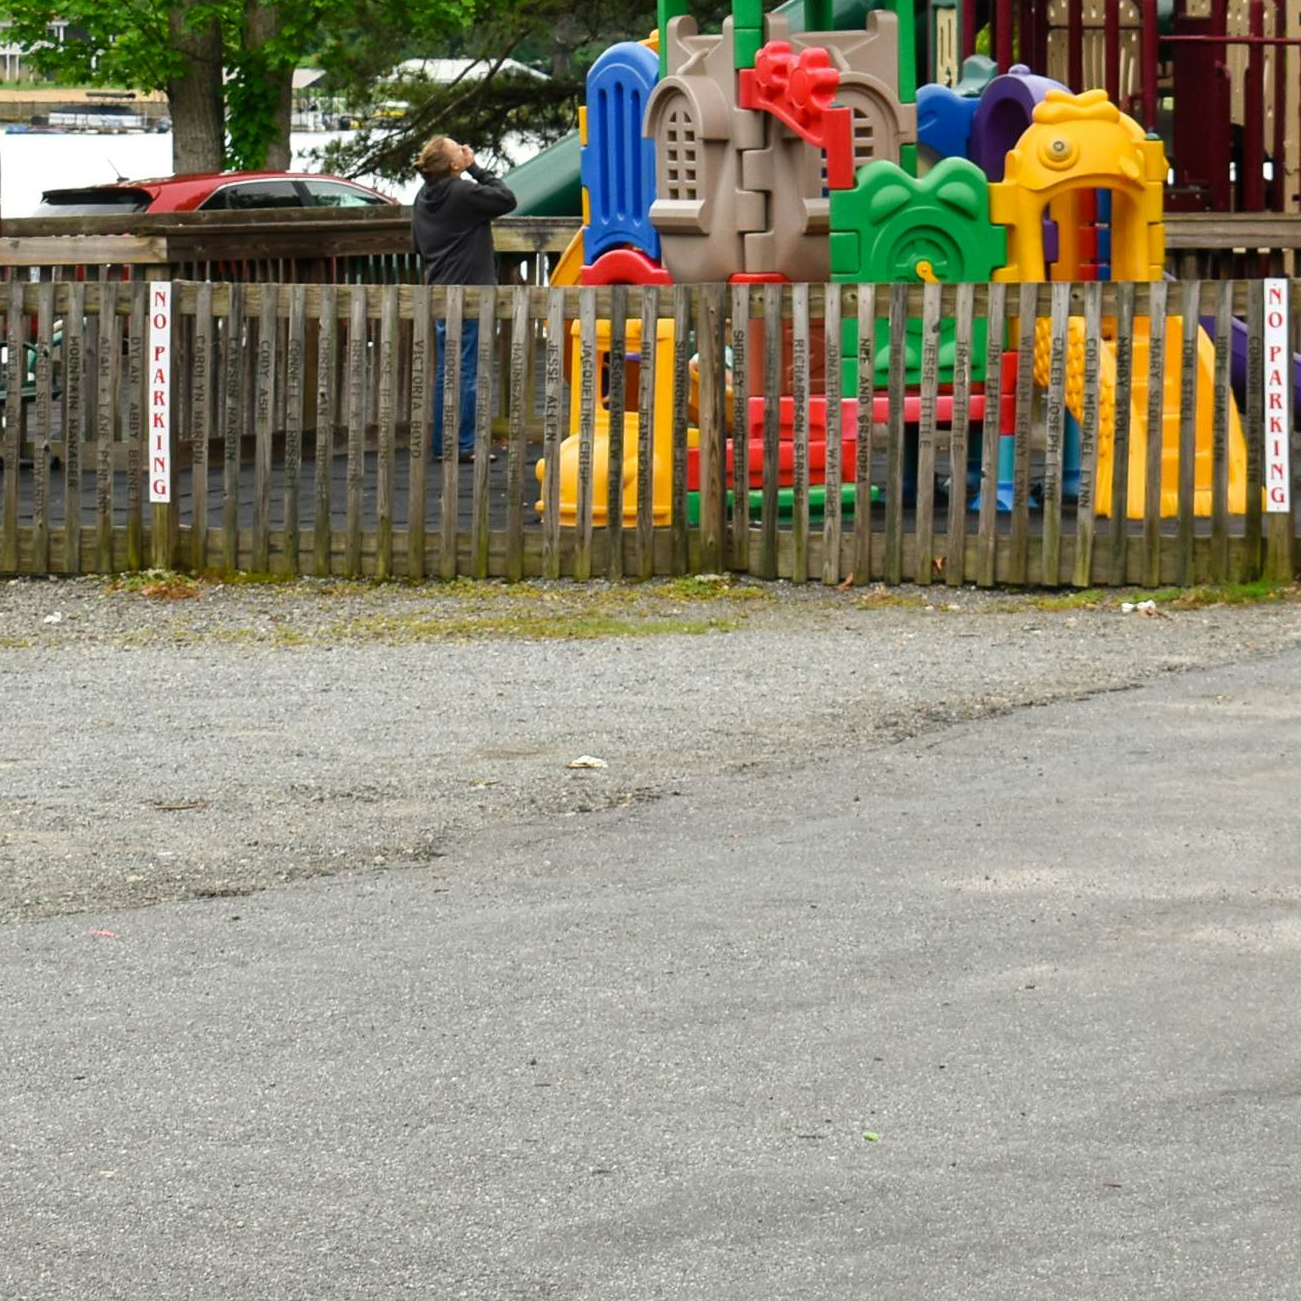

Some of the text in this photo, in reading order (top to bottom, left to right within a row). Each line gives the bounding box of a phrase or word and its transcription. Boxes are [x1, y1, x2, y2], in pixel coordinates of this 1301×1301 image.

[100, 337, 110, 377] ADAM
[130, 336, 141, 384] DYLAN
[153, 291, 167, 496] NO PARKING
[259, 340, 270, 379] CODY
[445, 340, 457, 394] BROOKE
[546, 340, 558, 442] JESSE ALLEN
[733, 330, 744, 388] SHIRLEY
[794, 339, 806, 433] RICHARDSON
[827, 340, 839, 423] JONATHAN
[859, 375, 871, 405] AND
[920, 339, 935, 449] JESSE TITTLE
[985, 340, 999, 429] JIM TITTLE
[1051, 336, 1063, 387] CALEB
[1114, 336, 1129, 445] MANDY STOLL
[1149, 337, 1161, 380] MARY
[1182, 337, 1193, 369] TOM
[1216, 336, 1227, 371] HOPE
[68, 335, 80, 490] MOUNTAIN MANAGER
[129, 402, 140, 440] ABBY
[193, 335, 206, 465] CAROLYN HARDIN
[226, 337, 239, 461] LAWSON HARDIN
[411, 340, 424, 459] VICTORIA BOYD
[639, 402, 650, 441] JEAN
[953, 340, 967, 453] TRACY TITTLE
[1048, 396, 1061, 454] JOSEPH
[1079, 338, 1097, 509] COLIN MICHAEL LYNN
[1247, 336, 1260, 484] CONNOR CHASTAIN
[1268, 288, 1285, 504] NO PARKING
[579, 440, 591, 484] CRISP
